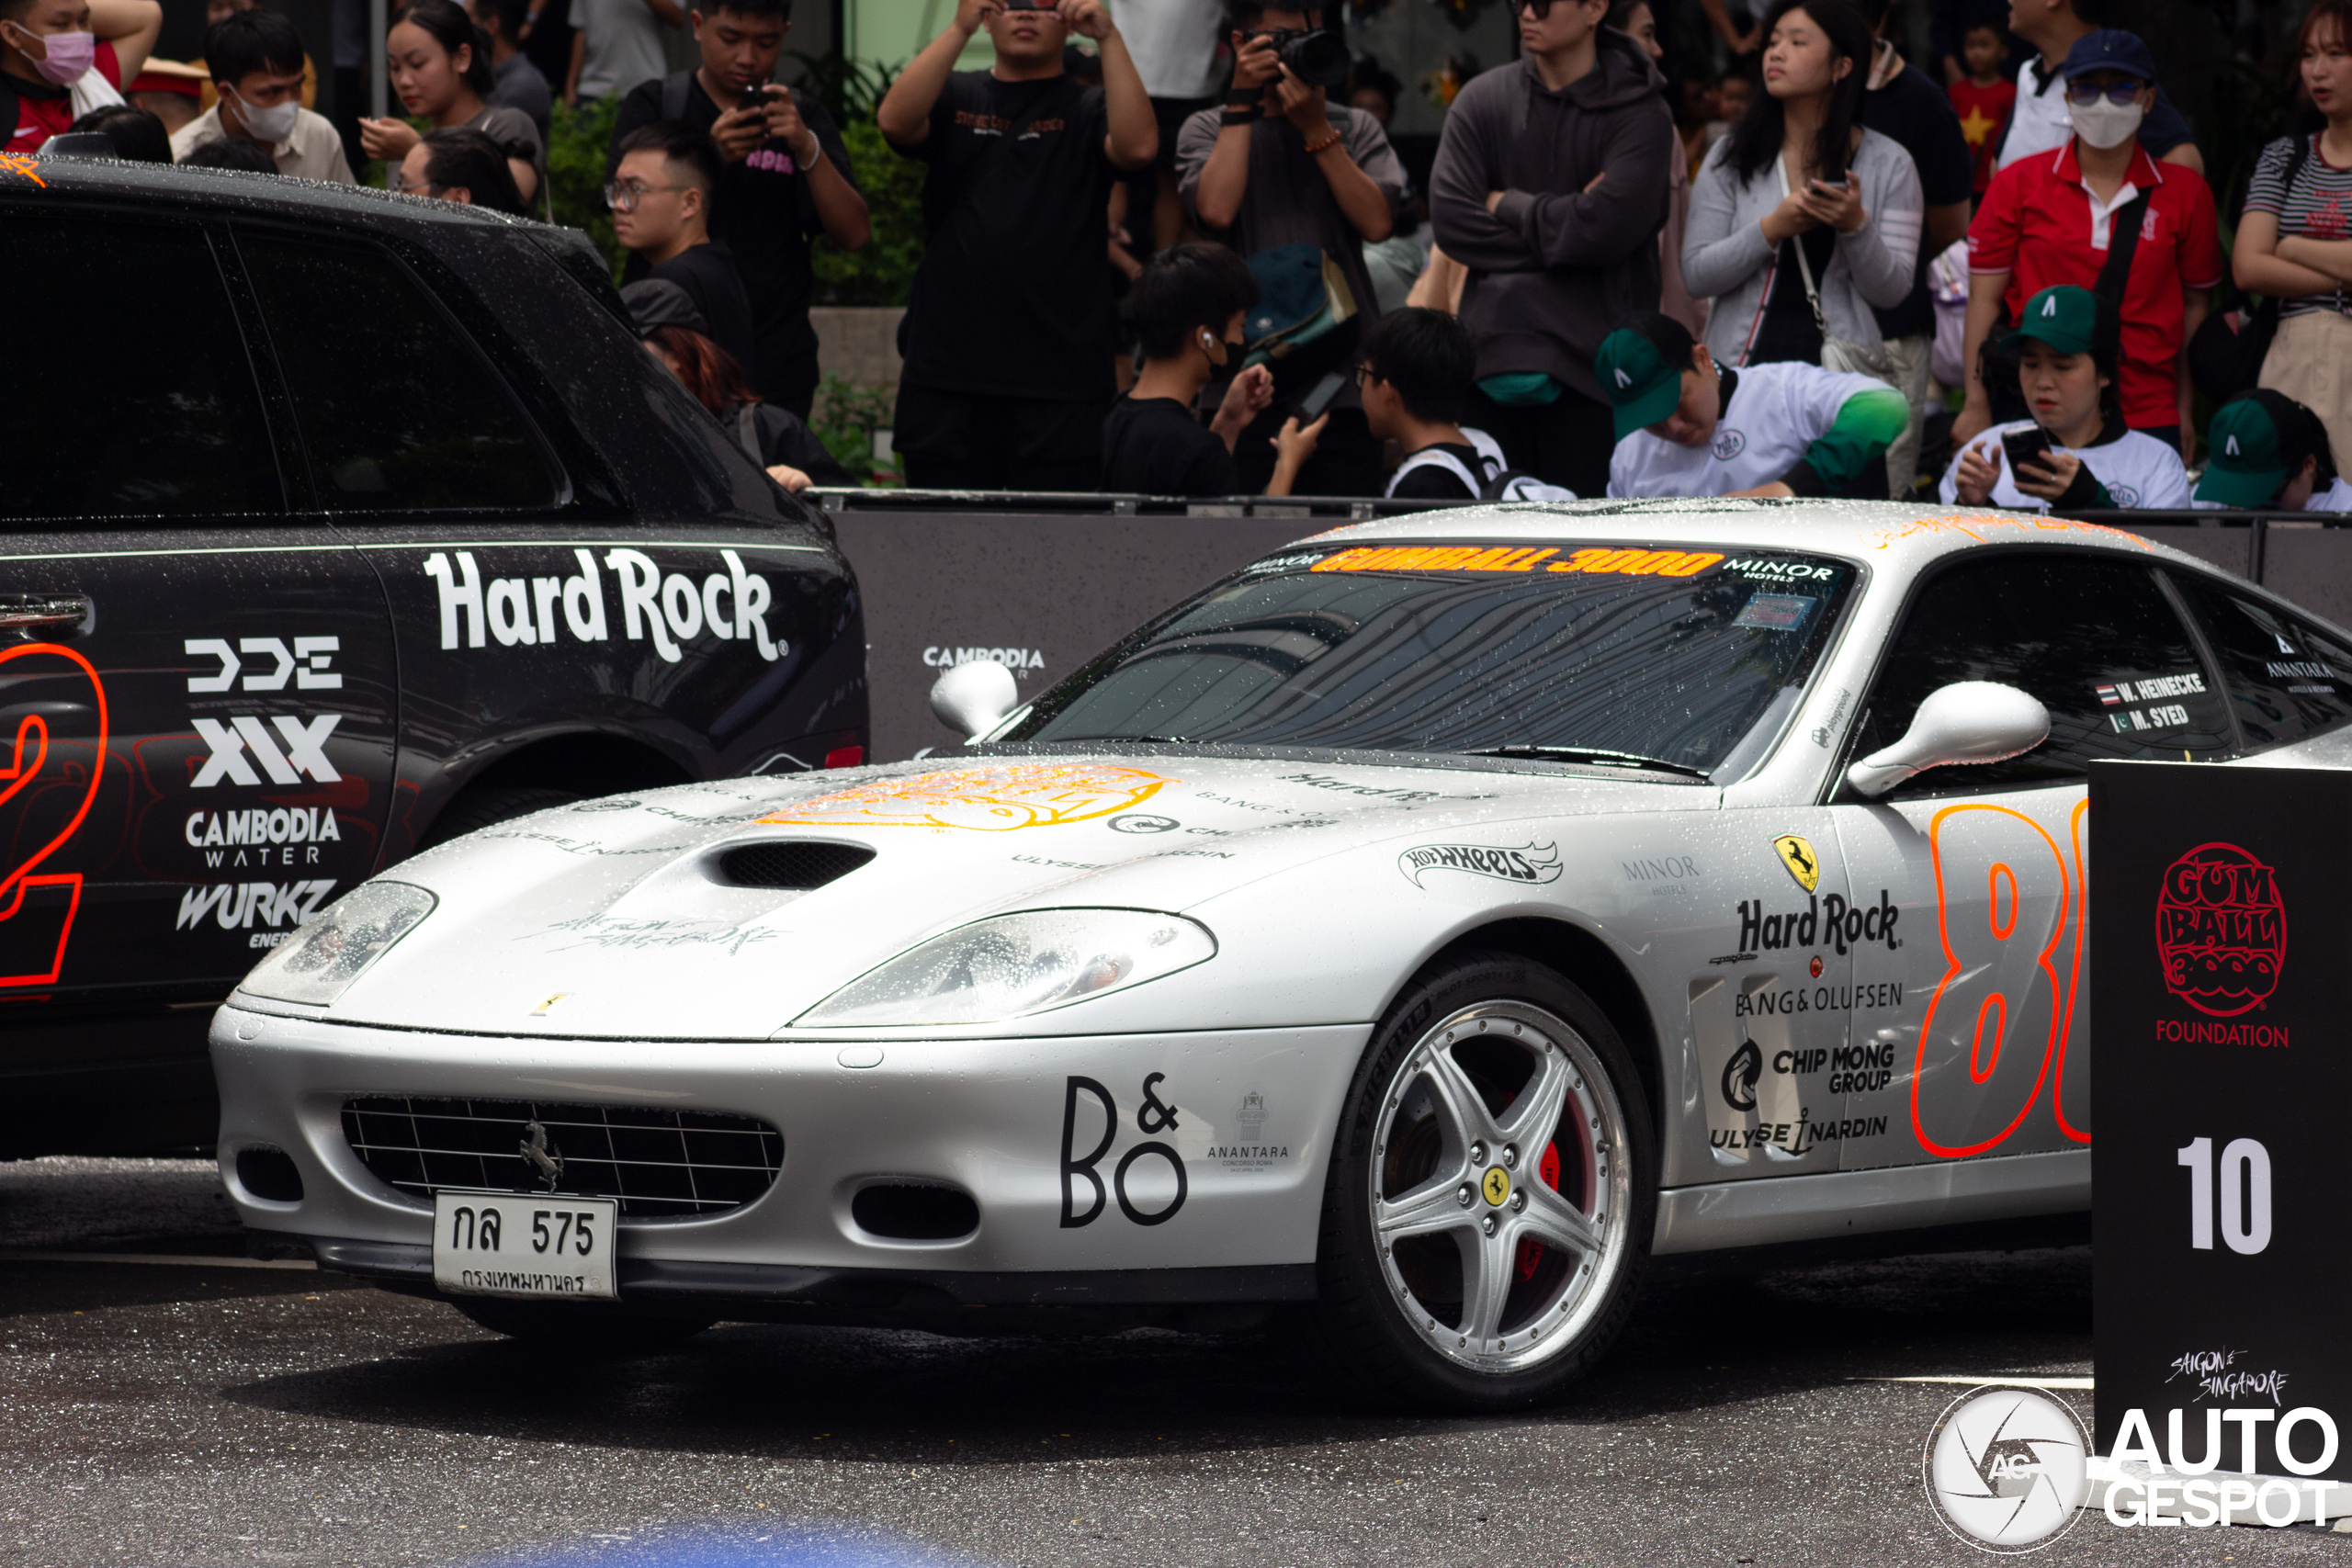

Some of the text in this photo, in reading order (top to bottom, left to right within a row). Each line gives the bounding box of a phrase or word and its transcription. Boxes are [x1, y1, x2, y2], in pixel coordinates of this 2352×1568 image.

[1310, 547, 1725, 577] GUMBALL 3000
[1723, 558, 1834, 581] MINOR
[1743, 571, 1796, 583] HOTELS
[423, 547, 779, 663] Hard Rock
[185, 636, 343, 693] DDE
[922, 647, 1046, 669] CAMBODIA
[2266, 661, 2335, 678] ANANTARA
[2116, 672, 2206, 703] W. HEINECKE
[1827, 687, 1851, 733] playground
[2129, 705, 2189, 731] M. SYED
[189, 714, 343, 788] XIX
[1194, 791, 1274, 811] BANG
[186, 807, 341, 847] CAMBODIA
[205, 846, 320, 868] WATER
[1622, 855, 1701, 883] MINOR
[175, 878, 338, 931] WURKZ
[1651, 884, 1687, 897] HOTELS
[1736, 888, 1899, 956] Hard Rock
[1910, 803, 2092, 1158] 8
[1736, 982, 1903, 1018] BANG & OLUFSEN
[2156, 1020, 2289, 1049] FOUNDATION
[1772, 1043, 1894, 1075] CHIP MONG
[1828, 1070, 1892, 1095] GROUP
[1808, 1116, 1889, 1143] NARDIN
[1207, 1146, 1289, 1158] ANANTARA
[2177, 1136, 2272, 1256] 10
[452, 1205, 502, 1252] กล
[532, 1210, 595, 1257] 575
[2165, 1345, 2226, 1384] SAIGON
[2192, 1370, 2290, 1407] SINGAPORE
